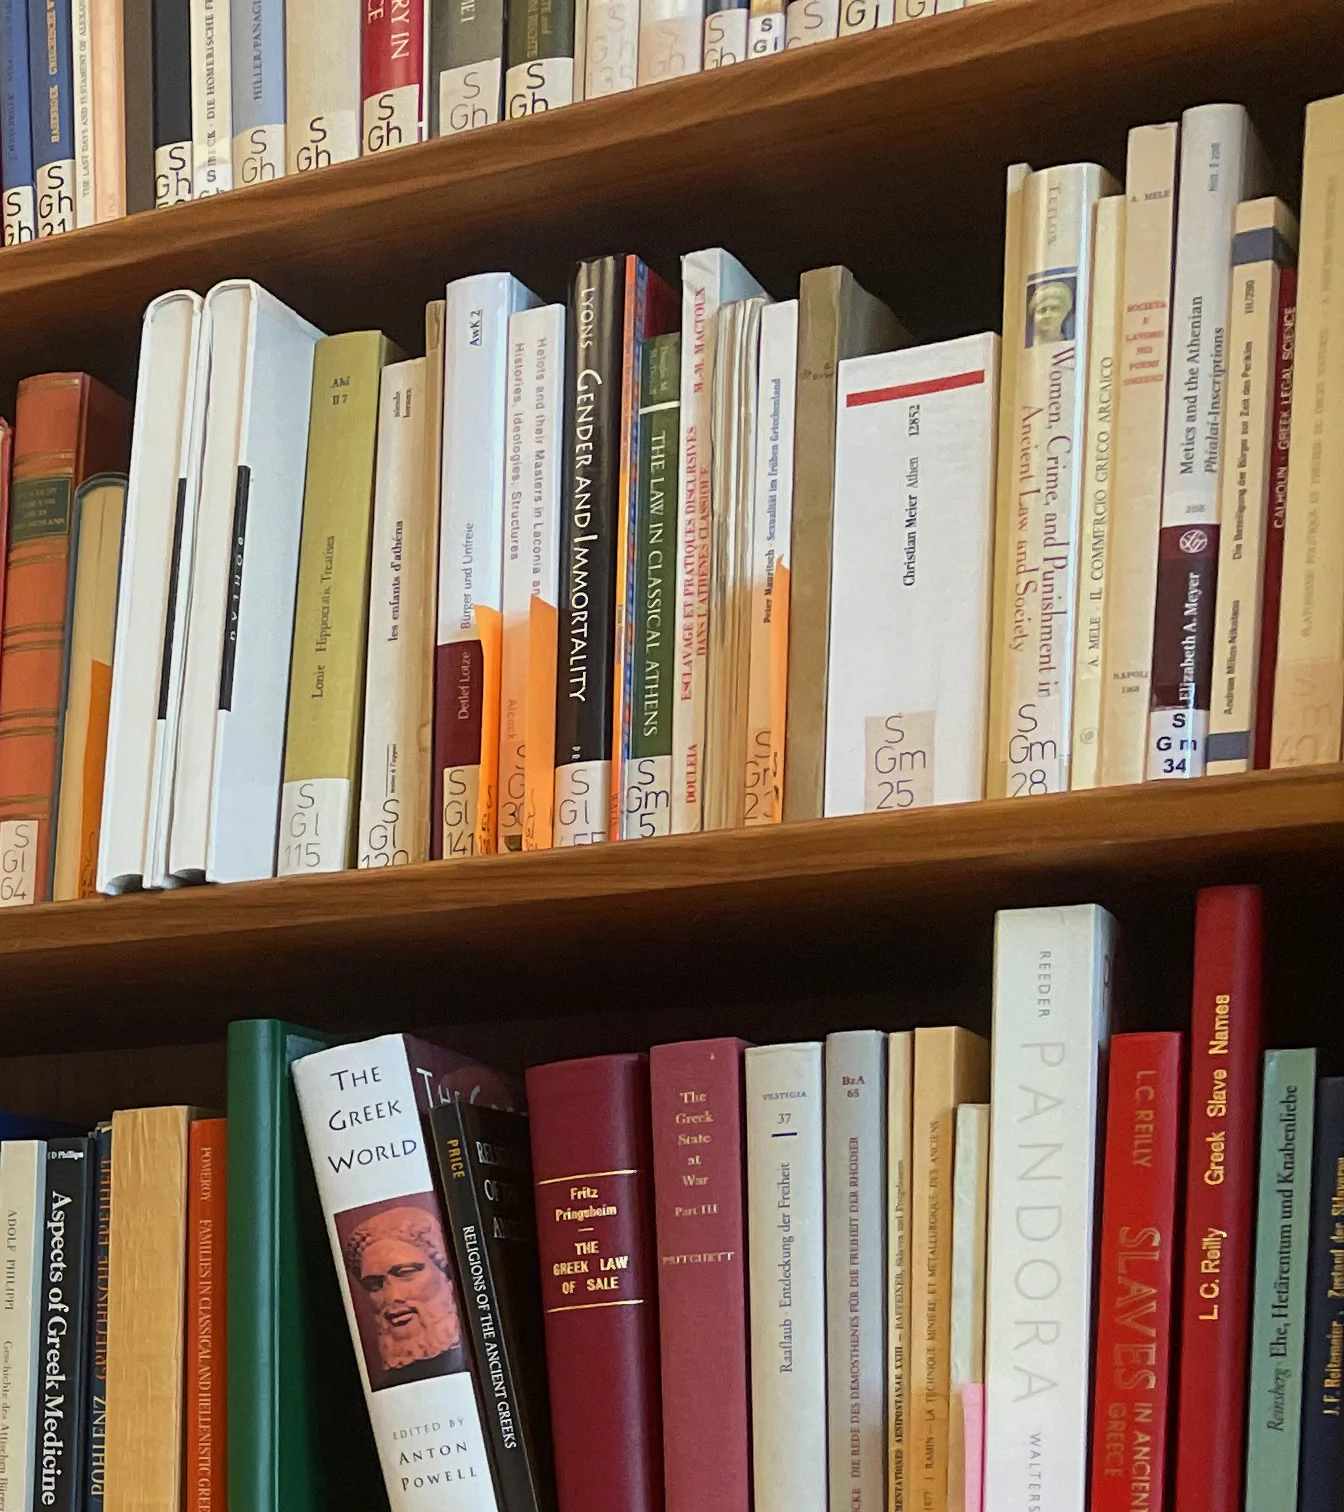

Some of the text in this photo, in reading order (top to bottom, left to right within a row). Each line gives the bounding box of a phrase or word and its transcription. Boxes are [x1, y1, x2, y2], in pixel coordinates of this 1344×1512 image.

[909, 404, 920, 437] 12852
[1046, 435, 1072, 506] Crime,
[568, 286, 603, 702] LYONS GENDER AND IMMORTALITY
[903, 456, 919, 587] Christian Meier Athen
[1009, 405, 1044, 653] Ancient Law and Society
[1044, 512, 1069, 548] and
[643, 430, 666, 738] THE LAW IN CLASSICAL ATHENS
[1184, 571, 1201, 613] Meyer
[1038, 555, 1068, 673] Punishment
[1178, 632, 1196, 701] Elizabeth
[1038, 682, 1058, 699] in
[885, 714, 905, 744] S
[874, 745, 926, 774] Gm
[876, 778, 914, 810] 25
[1037, 949, 1052, 1020] REEDER
[679, 1090, 707, 1104] The
[675, 1110, 714, 1125] Greek
[1278, 1083, 1298, 1185] Knabenliebe
[678, 1133, 711, 1146] State
[1133, 1108, 1155, 1168] REILLY
[1200, 994, 1231, 1283] Reilly Greek Slave Names
[446, 1138, 465, 1179] PRICE
[687, 1155, 701, 1166] at
[570, 1186, 599, 1200] Fritz
[682, 1173, 709, 1187] War
[555, 1204, 618, 1222] Pringsheim
[1011, 1041, 1066, 1404] PANDORA
[1276, 1188, 1291, 1225] und
[553, 1255, 629, 1276] GREEK LAW
[575, 1240, 600, 1256] THE
[562, 1276, 619, 1295] OF SALE
[777, 1161, 795, 1374] Raaflaub Entdeckung der Freiheit
[1272, 1228, 1291, 1323] Hetärentum
[1112, 1225, 1162, 1391] SLAVES
[41, 1190, 72, 1506] Aspects of Greek Medicine
[462, 1224, 517, 1449] RELIGIONS OF THE ANCIENT GREEKS
[1133, 1401, 1153, 1422] IN
[398, 1440, 469, 1466] ANTON
[401, 1465, 480, 1492] POWELL
